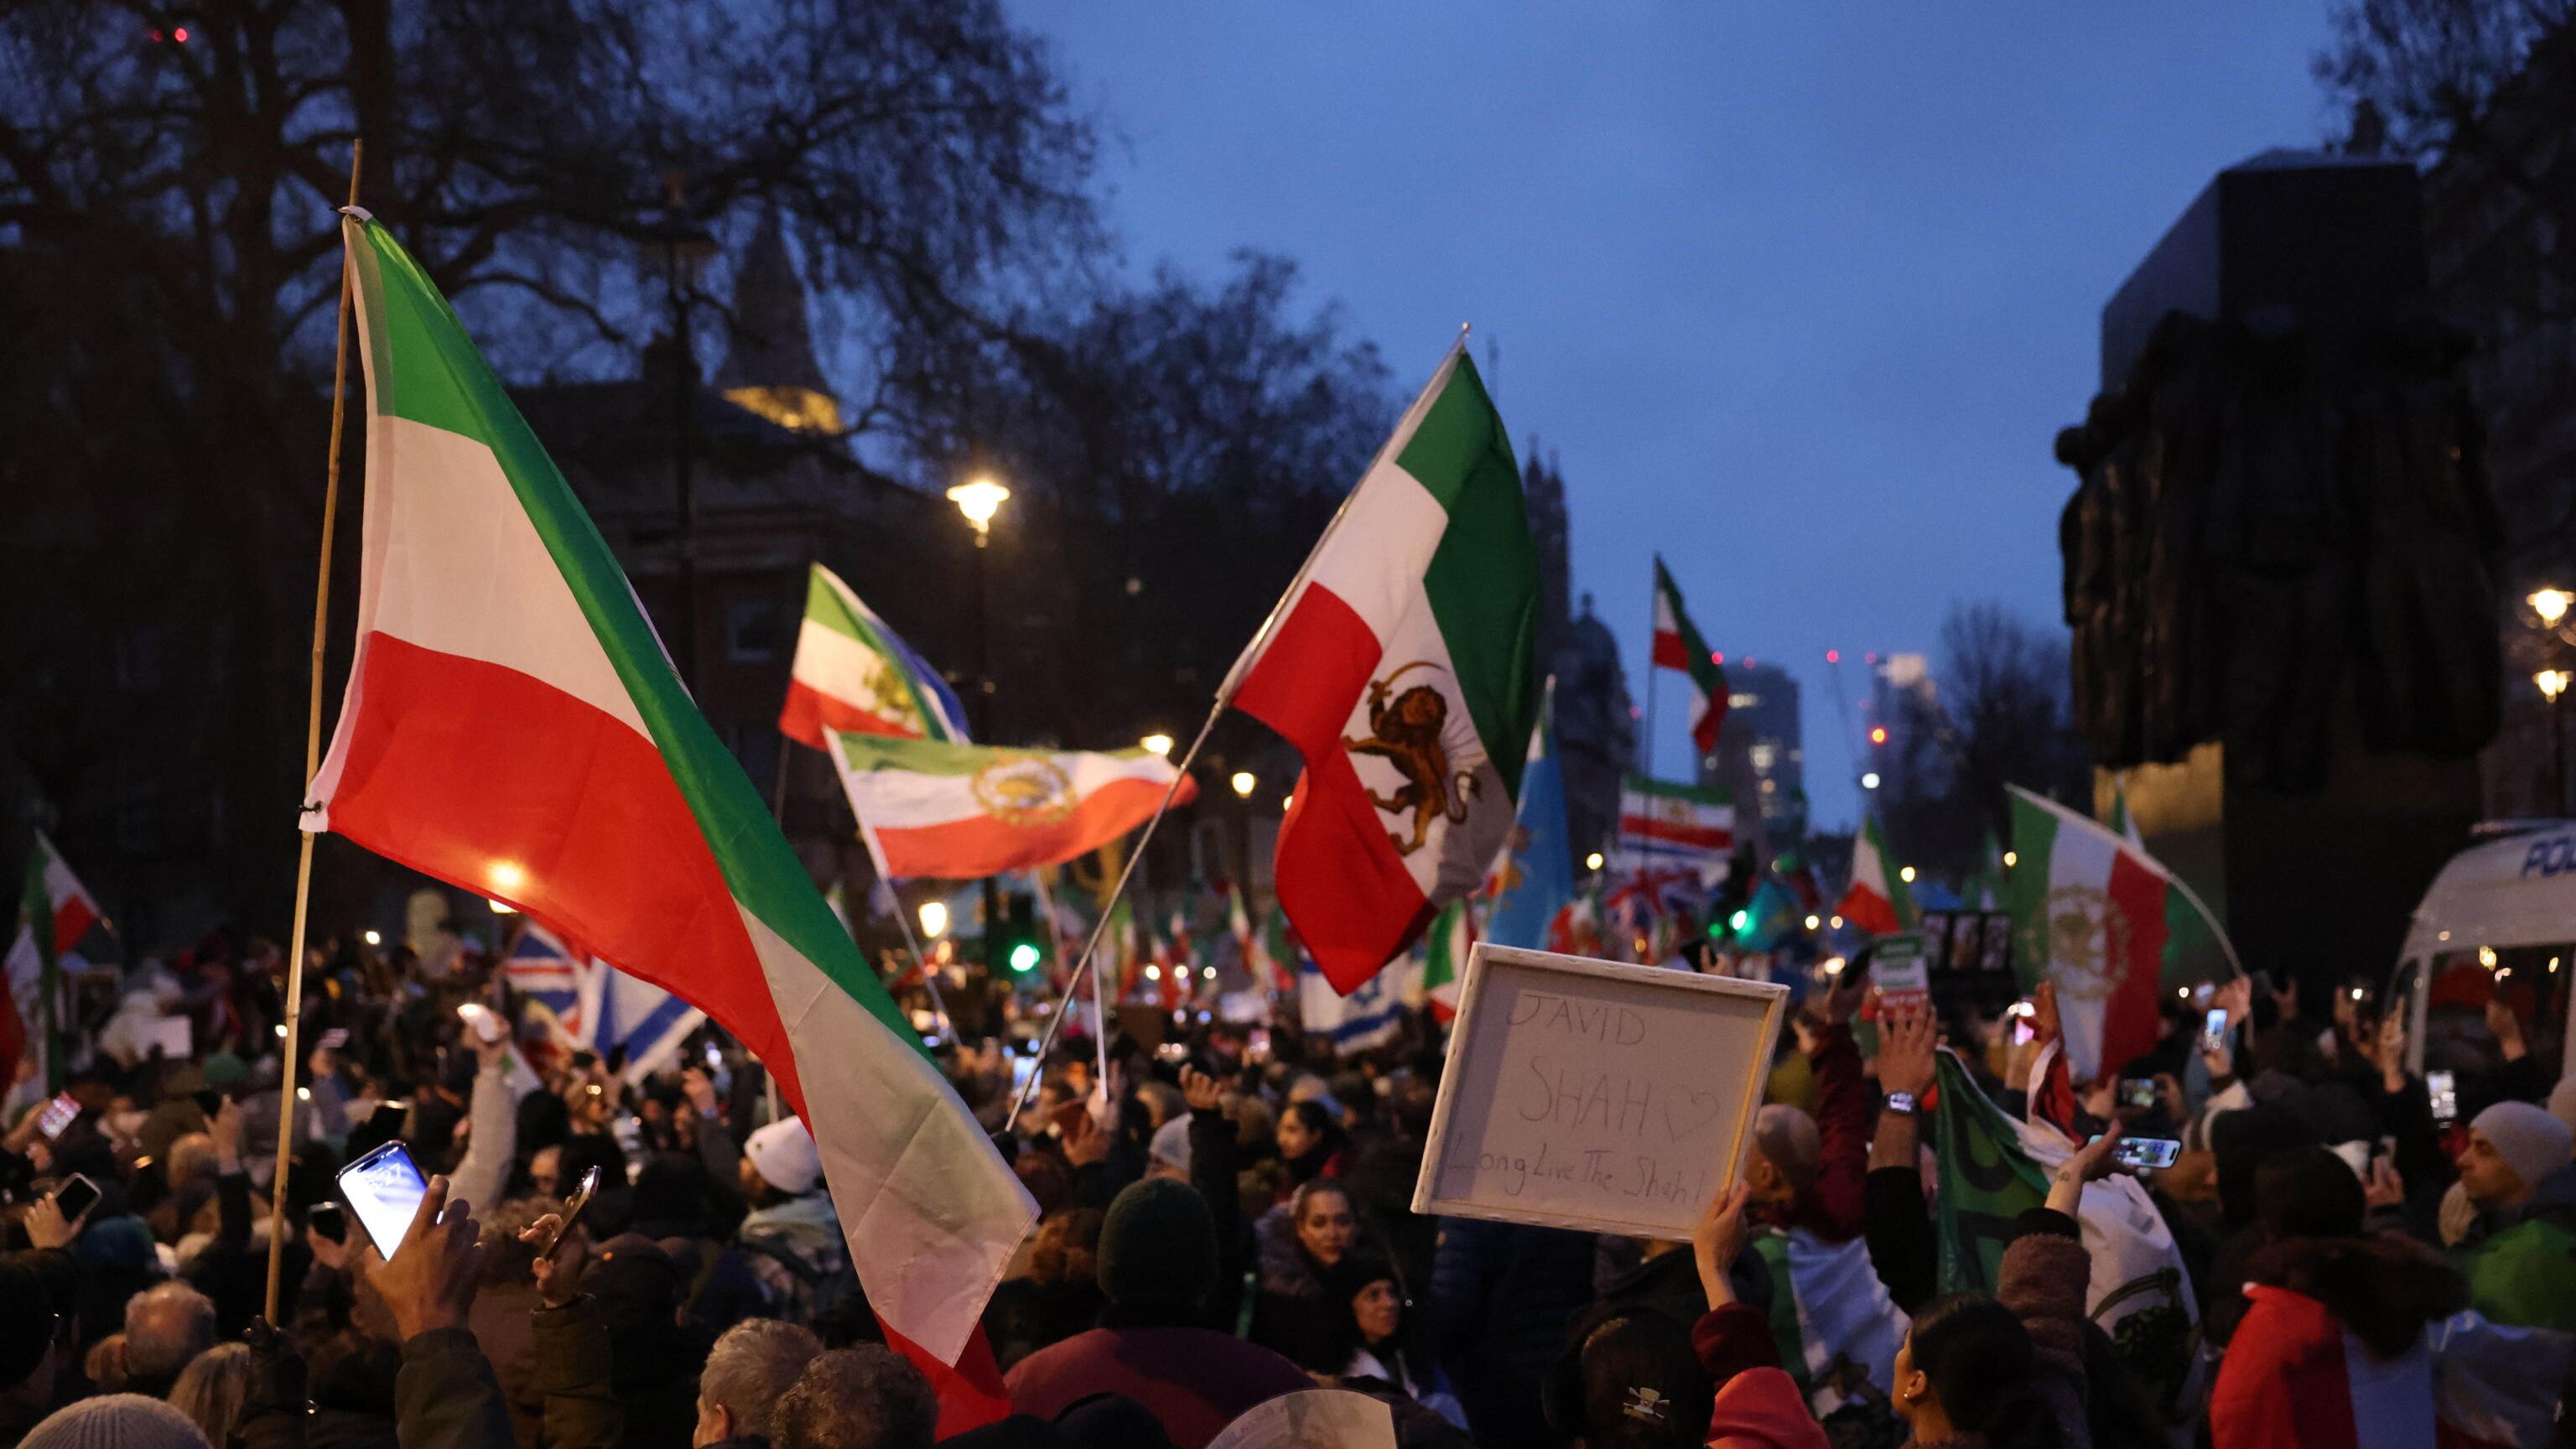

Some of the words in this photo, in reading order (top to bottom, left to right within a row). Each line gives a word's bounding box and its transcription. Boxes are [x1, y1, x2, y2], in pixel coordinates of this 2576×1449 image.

[1507, 993, 1646, 1046] JAVID
[1519, 1056, 1651, 1135] SHAH
[1448, 1133, 1526, 1197] Long
[1533, 1142, 1576, 1182] Live
[1583, 1150, 1615, 1191] The
